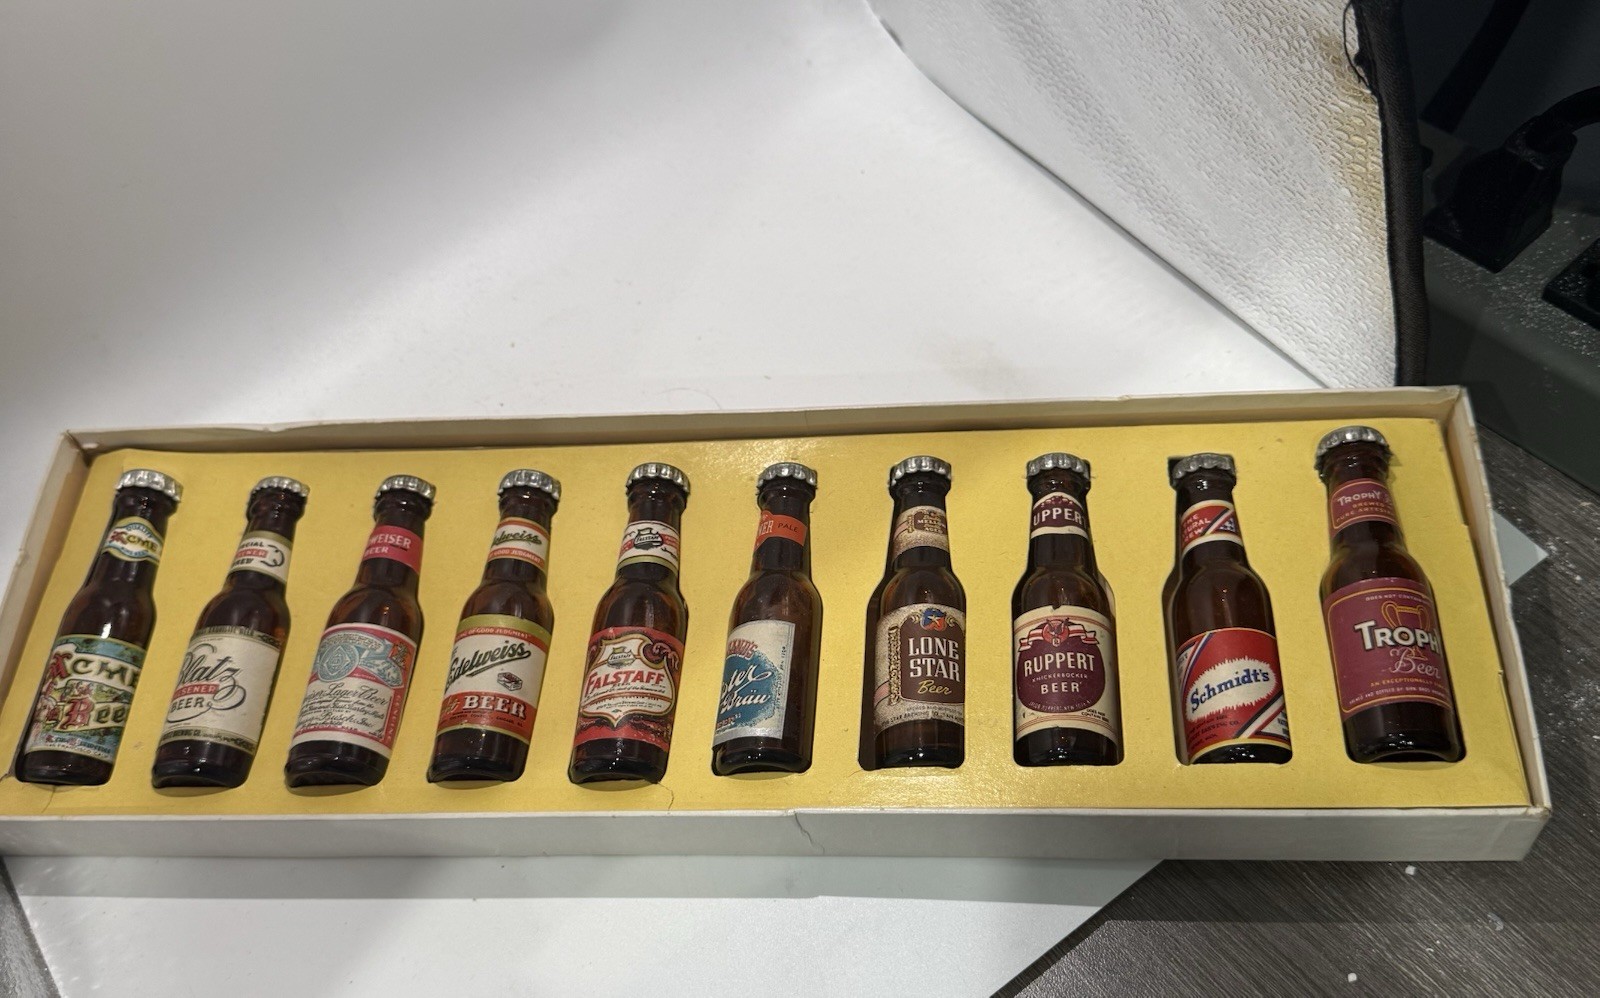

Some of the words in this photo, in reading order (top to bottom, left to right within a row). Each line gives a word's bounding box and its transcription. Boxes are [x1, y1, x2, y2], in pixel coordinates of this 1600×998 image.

[1338, 490, 1381, 506] TROPHY
[777, 522, 799, 532] PALE
[1033, 507, 1086, 528] UPPER
[369, 533, 412, 549] WEISER
[908, 636, 960, 660] LONE
[1354, 620, 1440, 655] TROPH
[445, 640, 531, 694] Edelweiss
[909, 658, 960, 682] STAR
[1024, 652, 1095, 677] RUPPERT
[1389, 646, 1441, 679] Beer
[584, 669, 665, 698] FALSTAFF
[917, 679, 952, 695] Beer
[1032, 673, 1088, 682] KNICKERBOCKER
[1040, 682, 1080, 694] BEER
[328, 682, 360, 701] Lager
[1190, 668, 1270, 713] Schmidt's
[59, 697, 126, 730] Bee
[170, 696, 205, 713] BEER
[462, 694, 526, 720] BEER
